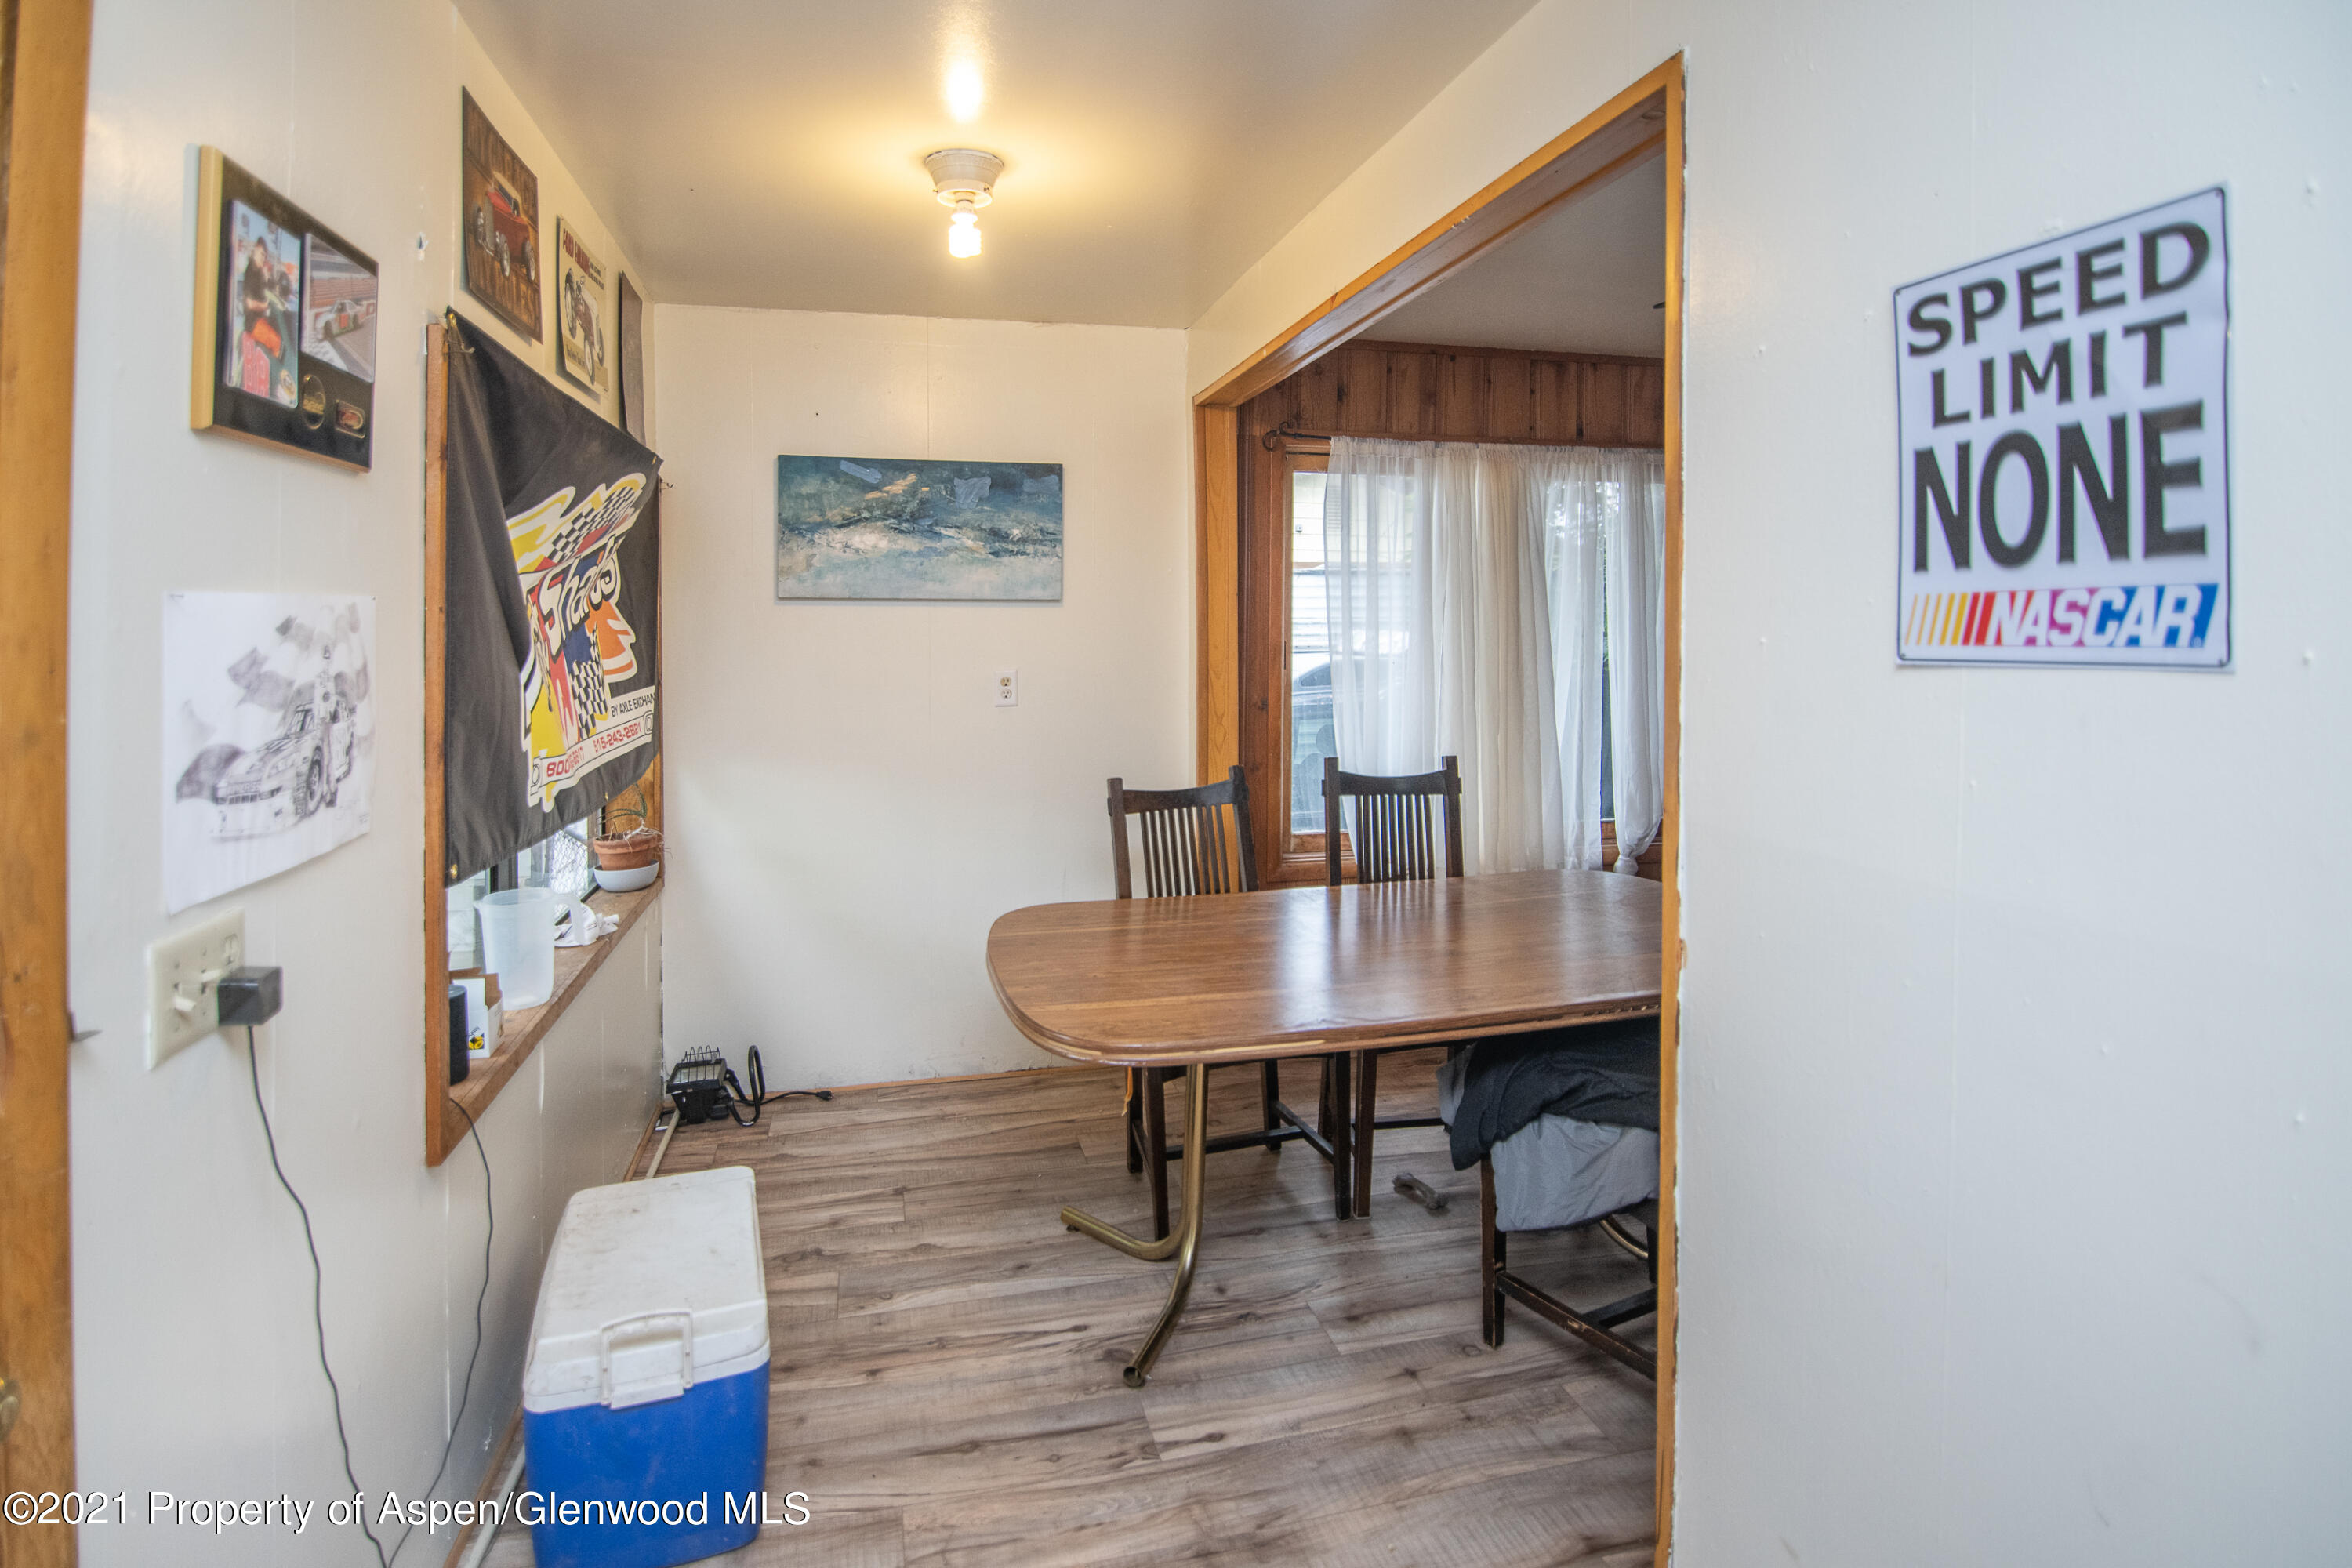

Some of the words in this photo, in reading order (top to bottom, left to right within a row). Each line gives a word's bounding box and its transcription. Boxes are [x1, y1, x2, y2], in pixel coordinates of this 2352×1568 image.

[1907, 222, 2210, 357] SPEED
[1931, 310, 2188, 428] LIMIT
[1913, 398, 2209, 574] NONE
[1984, 585, 2204, 648] NASCAR
[612, 705, 619, 717] BY
[620, 700, 633, 713] AXLE
